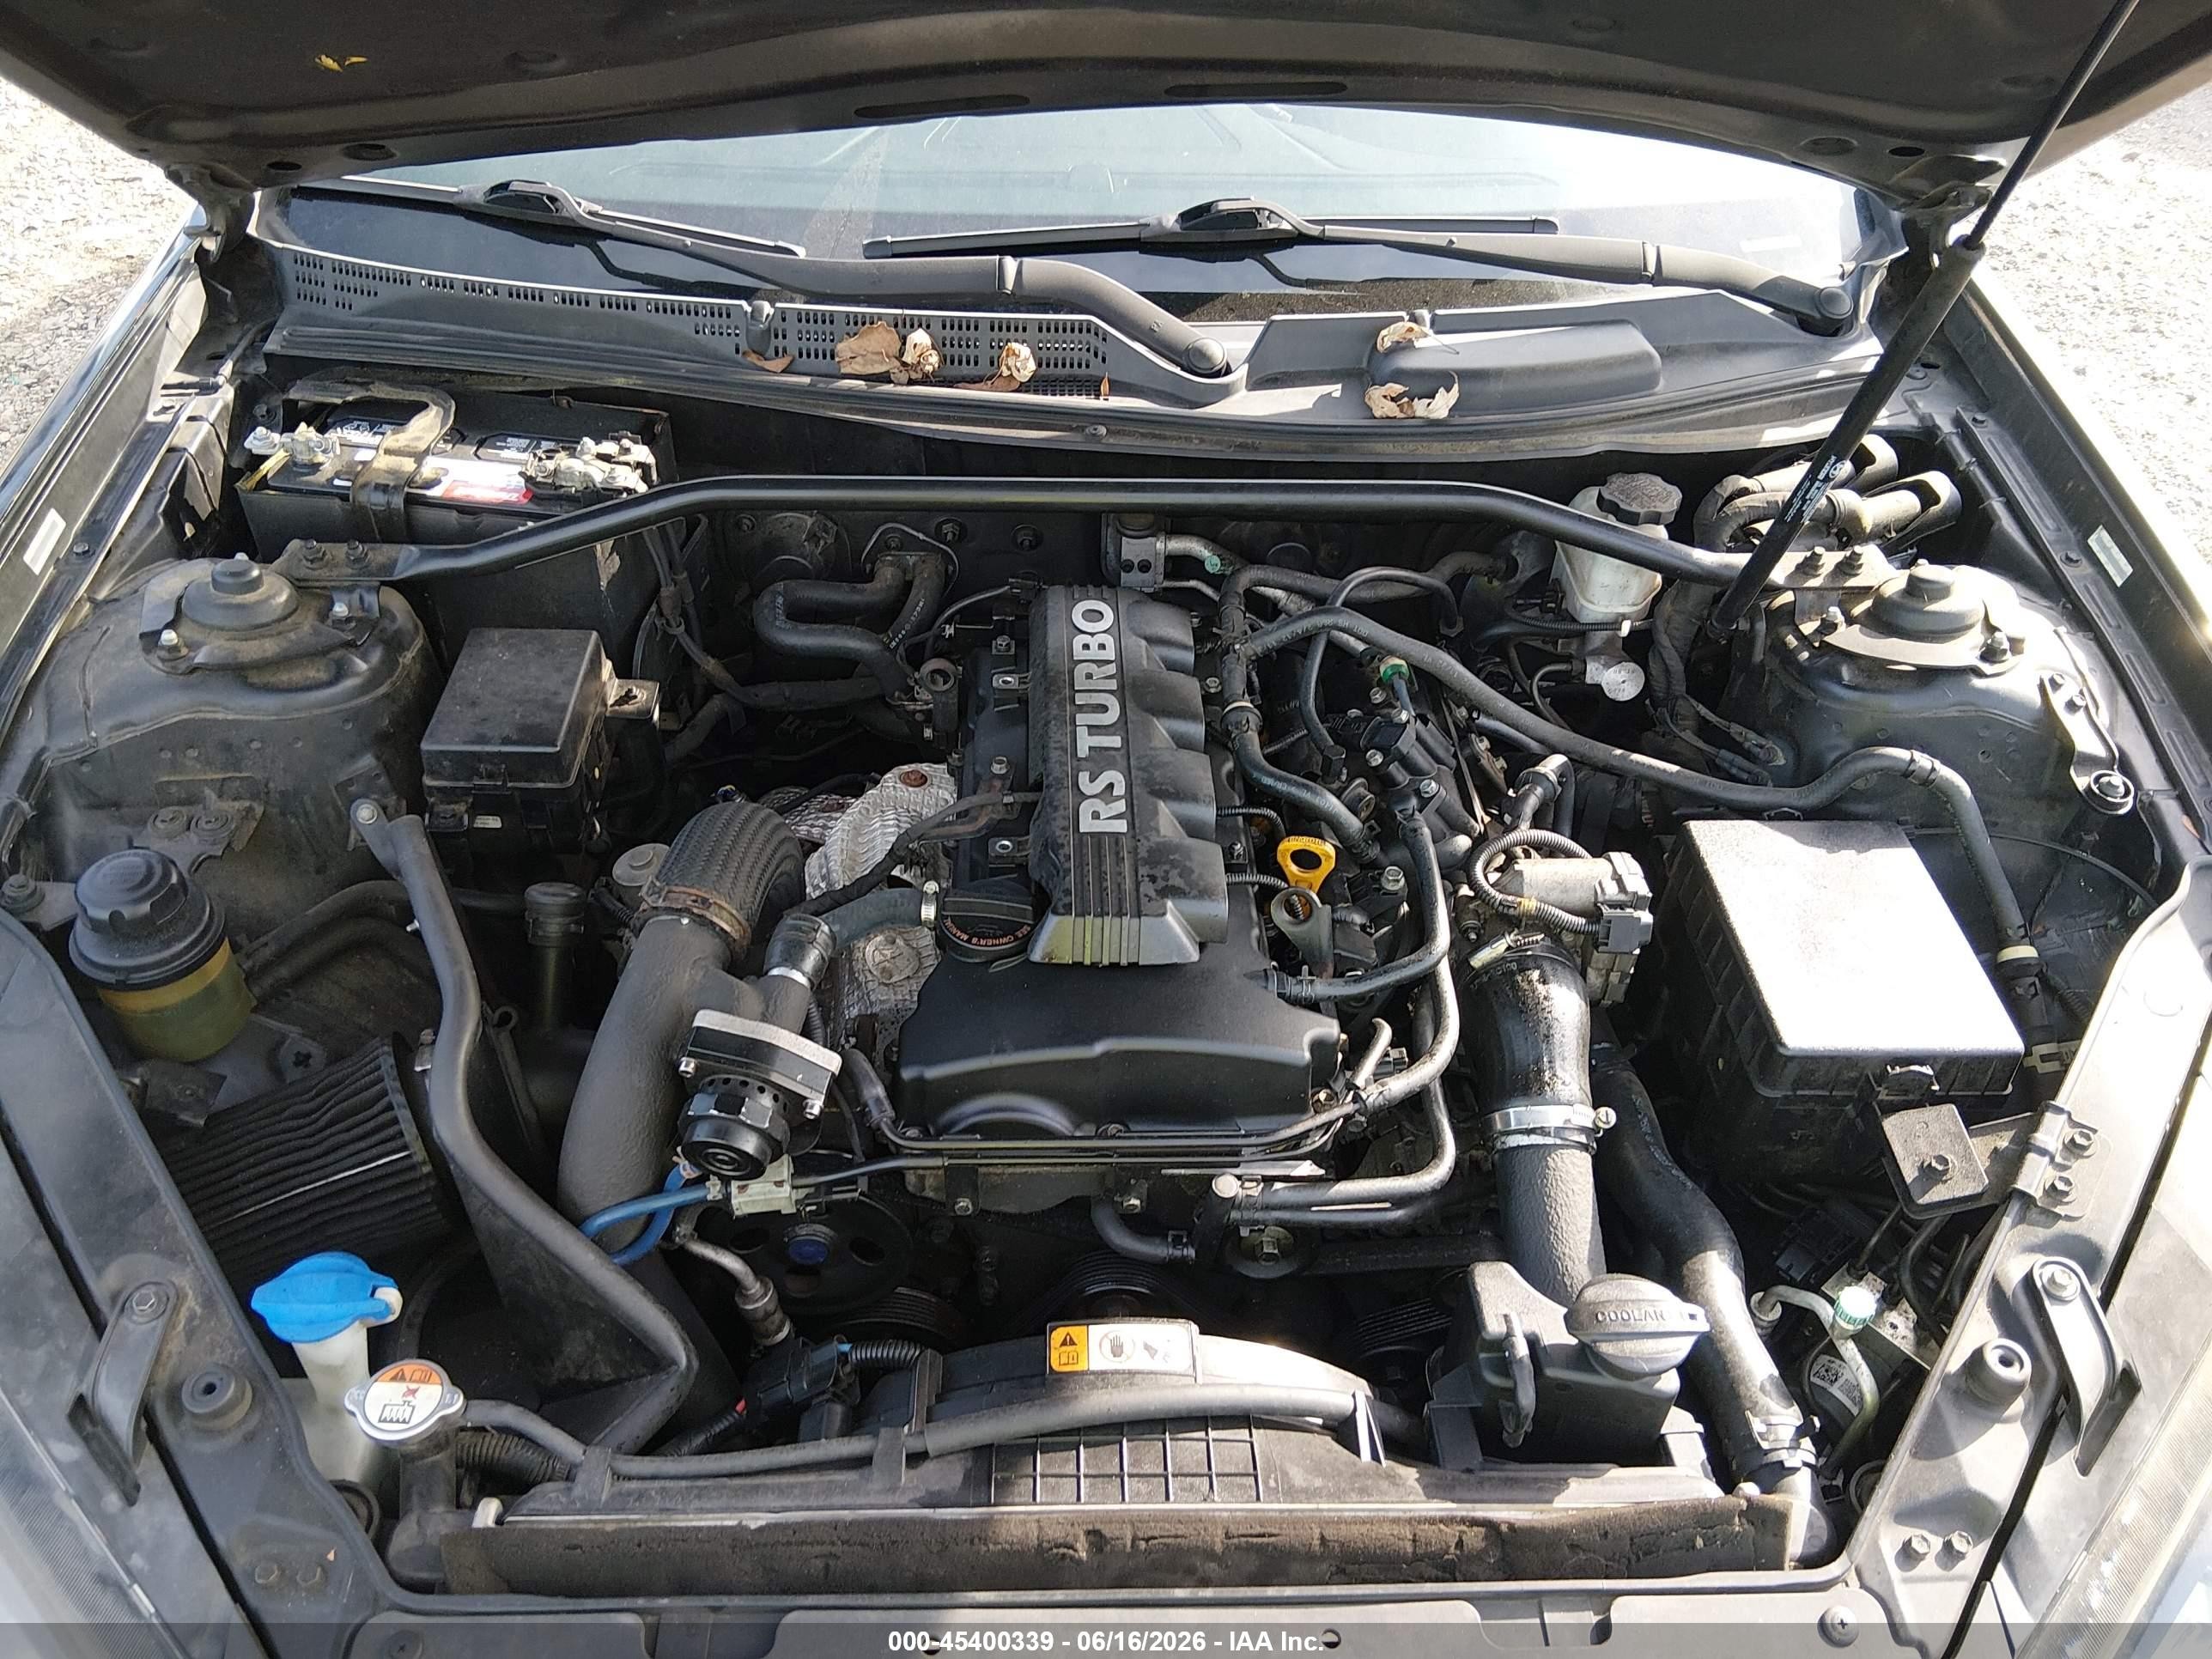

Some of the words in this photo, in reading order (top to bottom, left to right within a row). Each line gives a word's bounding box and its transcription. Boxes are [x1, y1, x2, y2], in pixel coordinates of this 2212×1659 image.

[1071, 599, 1121, 757] TURBO
[1078, 769, 1128, 834] RS
[971, 935, 1014, 946] OWNER'S
[1017, 924, 1031, 939] SEE
